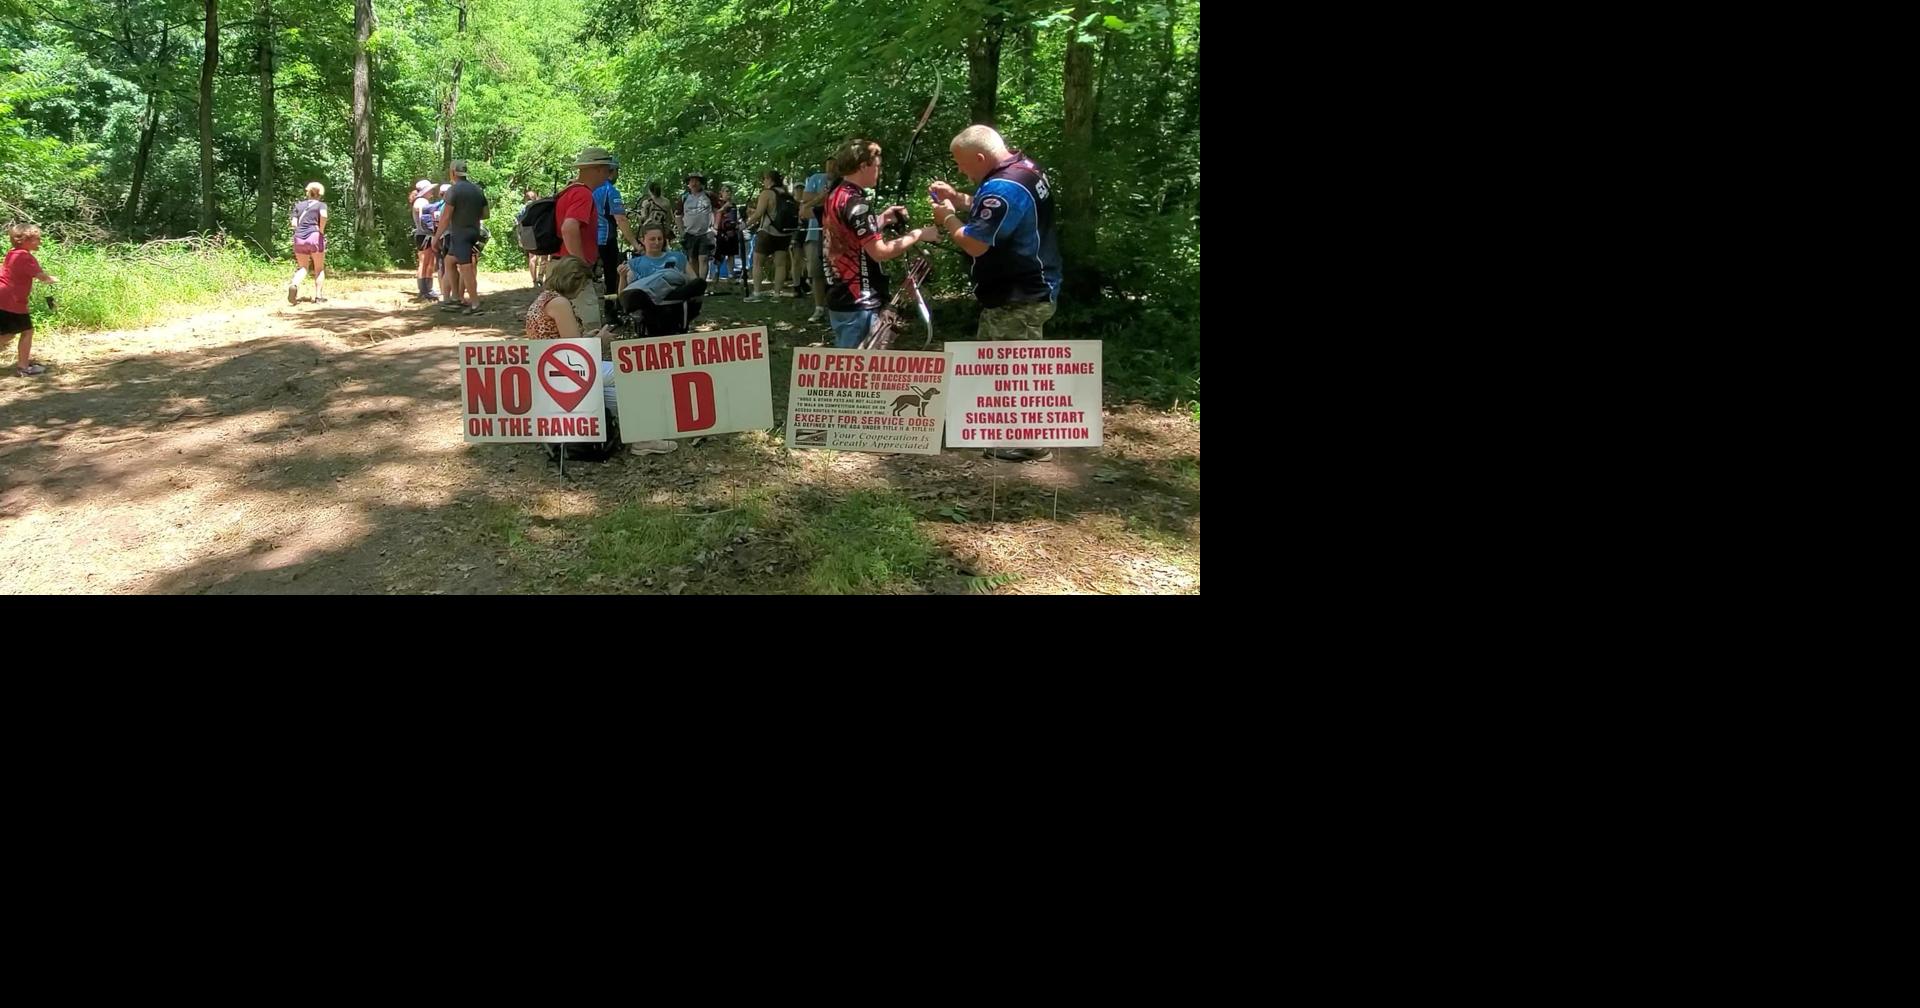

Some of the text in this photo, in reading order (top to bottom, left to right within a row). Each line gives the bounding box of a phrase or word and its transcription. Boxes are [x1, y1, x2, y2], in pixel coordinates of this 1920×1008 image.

[465, 346, 530, 365] PLEASE
[618, 333, 763, 373] START RANGE
[978, 347, 1072, 359] NO SPECTATORS
[798, 354, 945, 374] NO PETS ALLOWED
[955, 363, 1094, 376] ALLOWED ON THE RANGE
[798, 372, 868, 389] ON RANGE
[883, 374, 912, 382] ACCESS
[913, 375, 942, 383] ROUTES
[466, 366, 532, 415] NO
[995, 380, 1055, 391] UNTIL THE
[671, 372, 716, 432] D
[977, 396, 1073, 408] RANGE OFFICIAL
[795, 413, 935, 427] EXCEPT FOR SERVICE DOGS
[966, 412, 1084, 424] SIGNALS THE START
[469, 417, 600, 436] ON THE RANGE
[859, 432, 918, 441] Cooperation
[962, 428, 1088, 440] OF THE COMPETITION
[832, 440, 866, 448] Greatly
[872, 441, 929, 450] Appreciated
